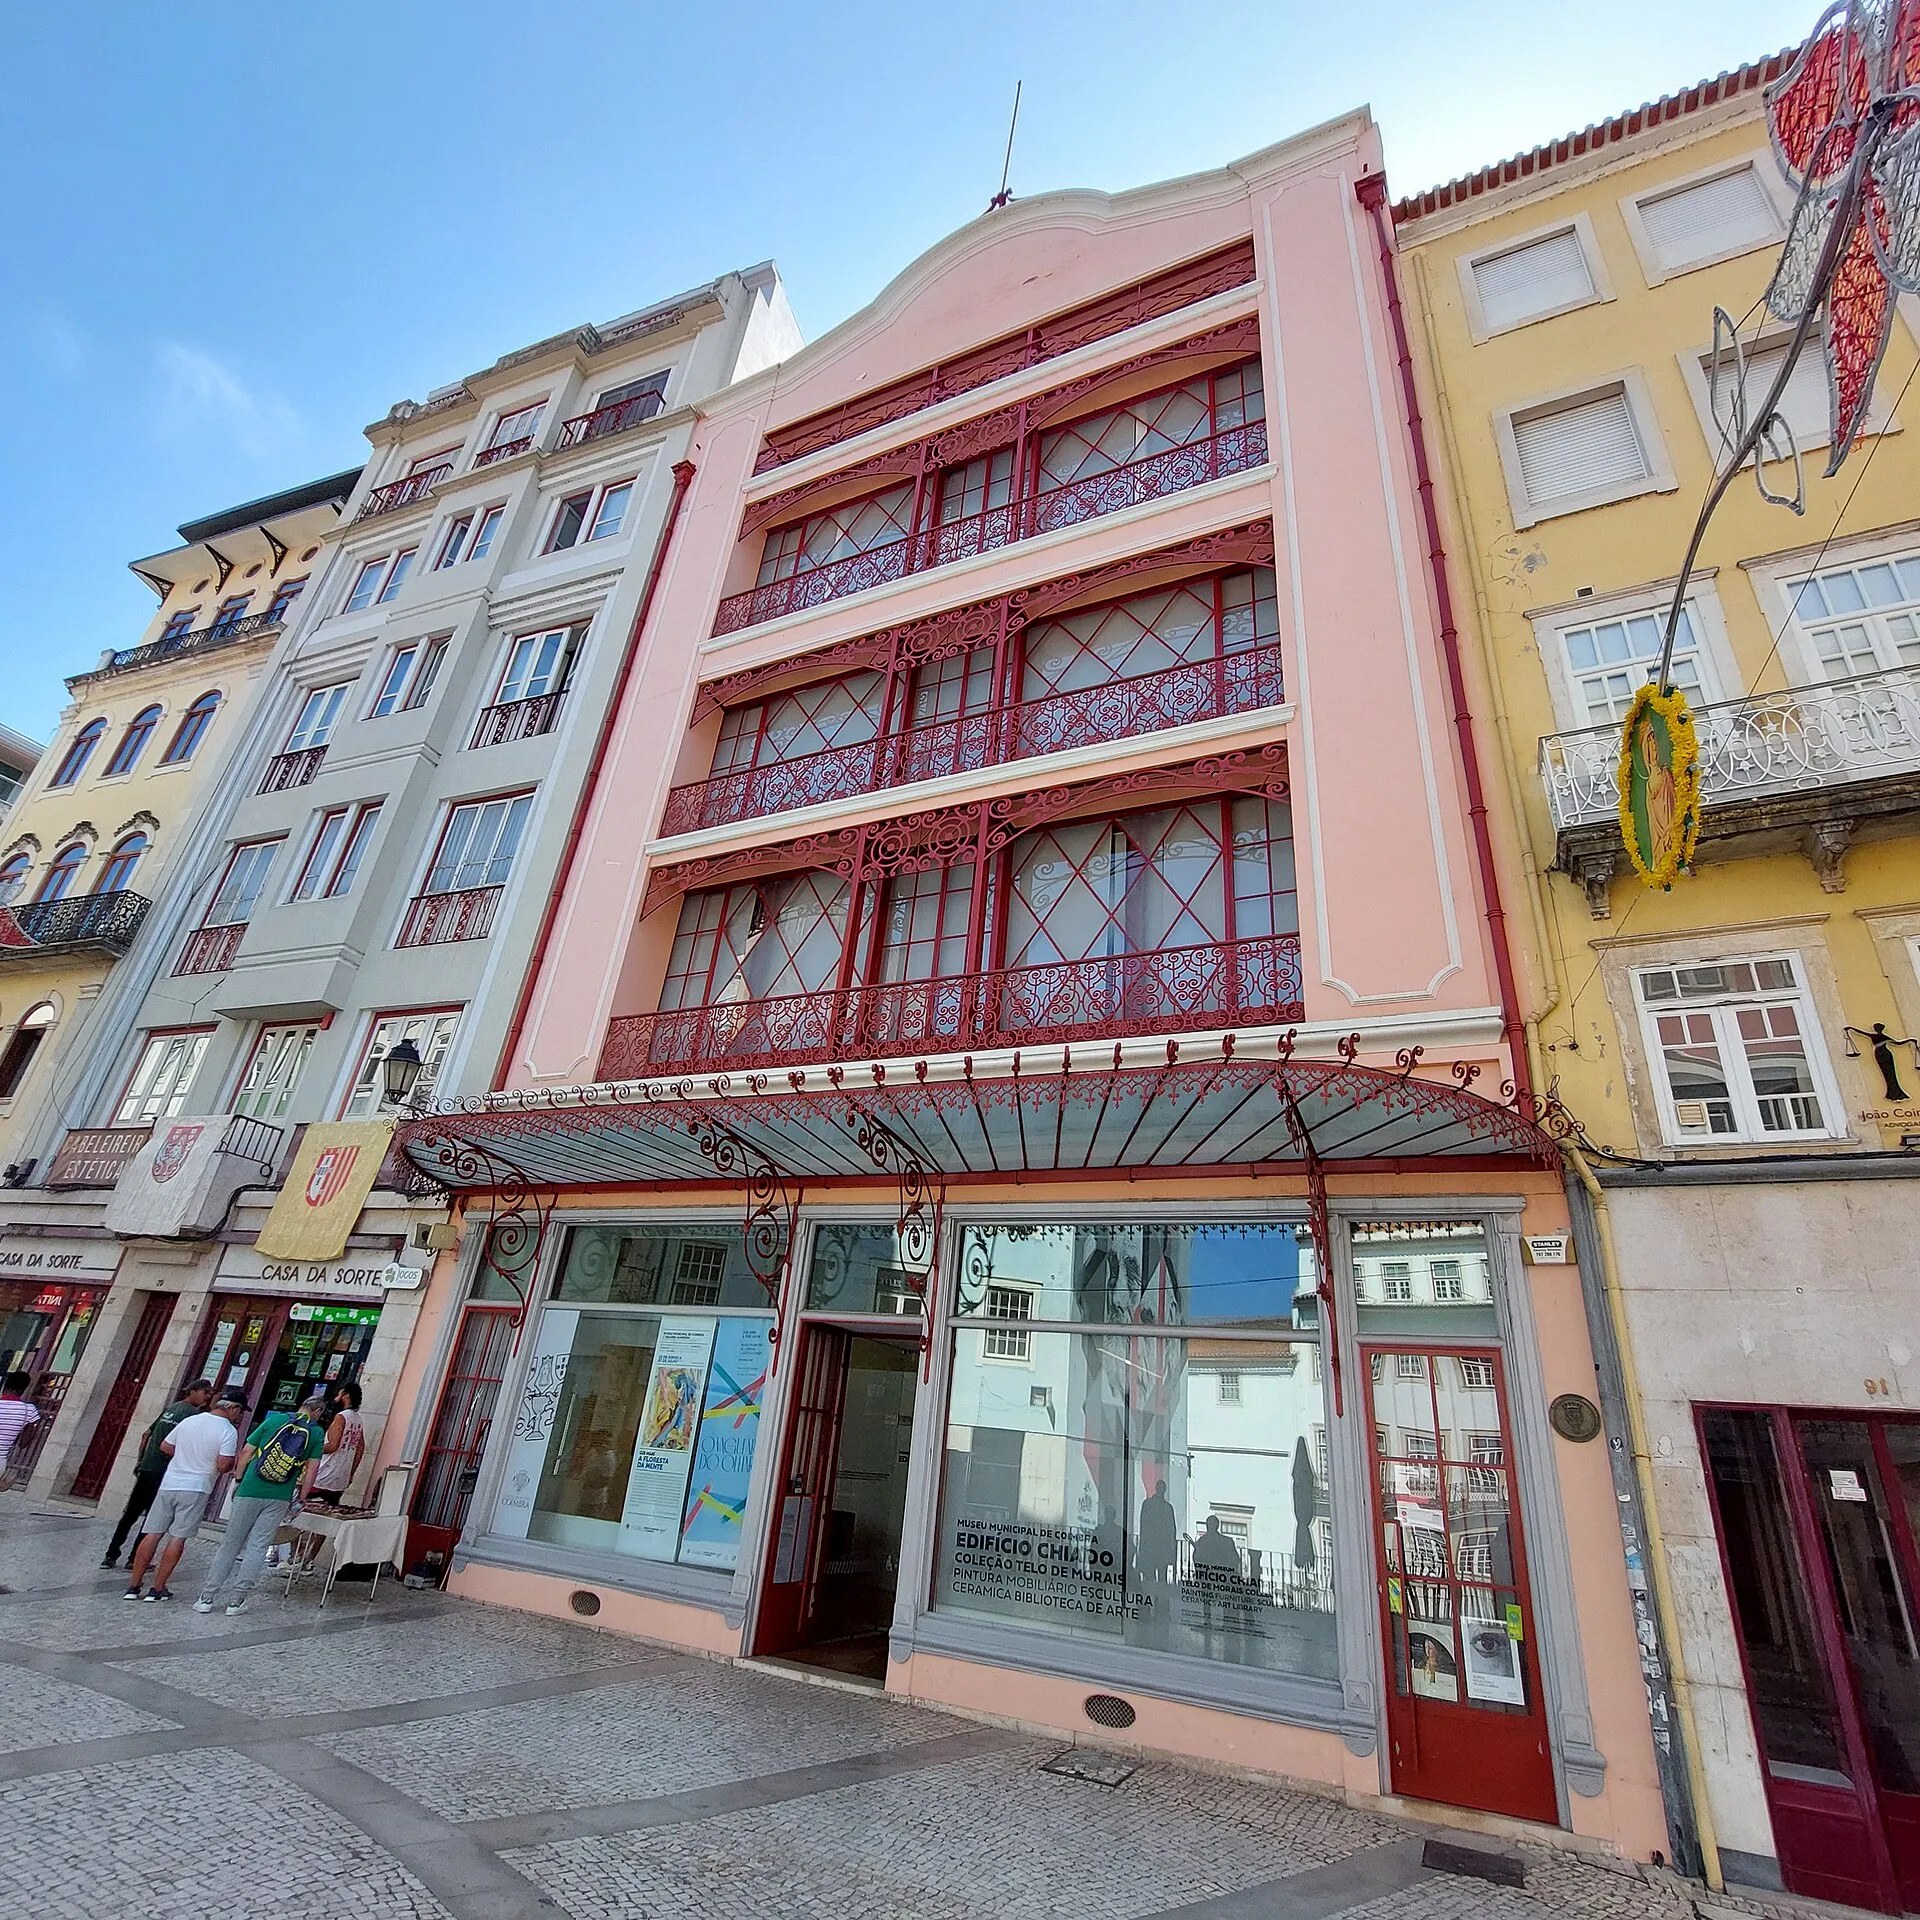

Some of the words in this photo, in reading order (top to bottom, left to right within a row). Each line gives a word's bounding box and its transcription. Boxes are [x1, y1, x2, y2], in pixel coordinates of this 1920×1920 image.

[1861, 1109, 1889, 1122] João
[62, 1134, 145, 1153] CABELEIREIR
[63, 1158, 125, 1179] ESTÉTICA
[27, 1254, 43, 1267] DA
[47, 1255, 83, 1269] SORTE
[262, 1265, 299, 1281] CASA
[306, 1266, 327, 1282] DA
[334, 1268, 381, 1286] SORTE
[396, 1270, 418, 1281] JOGOS
[1864, 1379, 1888, 1395] 91
[643, 1456, 669, 1464] FLORESTA
[645, 1462, 663, 1470] MENTE
[957, 1518, 987, 1530] MUSEU
[989, 1522, 1038, 1536] MUNICIPAL
[1040, 1529, 1053, 1538] DE
[956, 1532, 1032, 1556] EDIFÍCIO
[1037, 1542, 1114, 1567] CHIADO
[955, 1552, 1013, 1571] COLEÇÃO
[1016, 1560, 1048, 1575] TELO
[1051, 1565, 1068, 1578] DE
[1071, 1567, 1124, 1586] MORAIS
[1211, 1565, 1235, 1573] MUSEUM
[953, 1567, 1003, 1584] PINTURA
[1006, 1574, 1077, 1595] MOBILIÁRIO
[1080, 1585, 1154, 1607] ESCULTURA
[1181, 1580, 1200, 1589] TELO
[1201, 1582, 1213, 1590] DE
[1213, 1584, 1244, 1595] MORAIS
[952, 1581, 1012, 1600] CERAMICA
[1014, 1590, 1083, 1612] BIBLIOTECA
[1087, 1601, 1103, 1614] DE
[1106, 1604, 1140, 1620] ARTE
[1181, 1588, 1217, 1600] PAINTING
[1216, 1592, 1256, 1605] FURNITURE
[1181, 1595, 1217, 1608] CERAMICS
[1218, 1601, 1232, 1609] ART
[1232, 1602, 1263, 1613] LIBRARY
